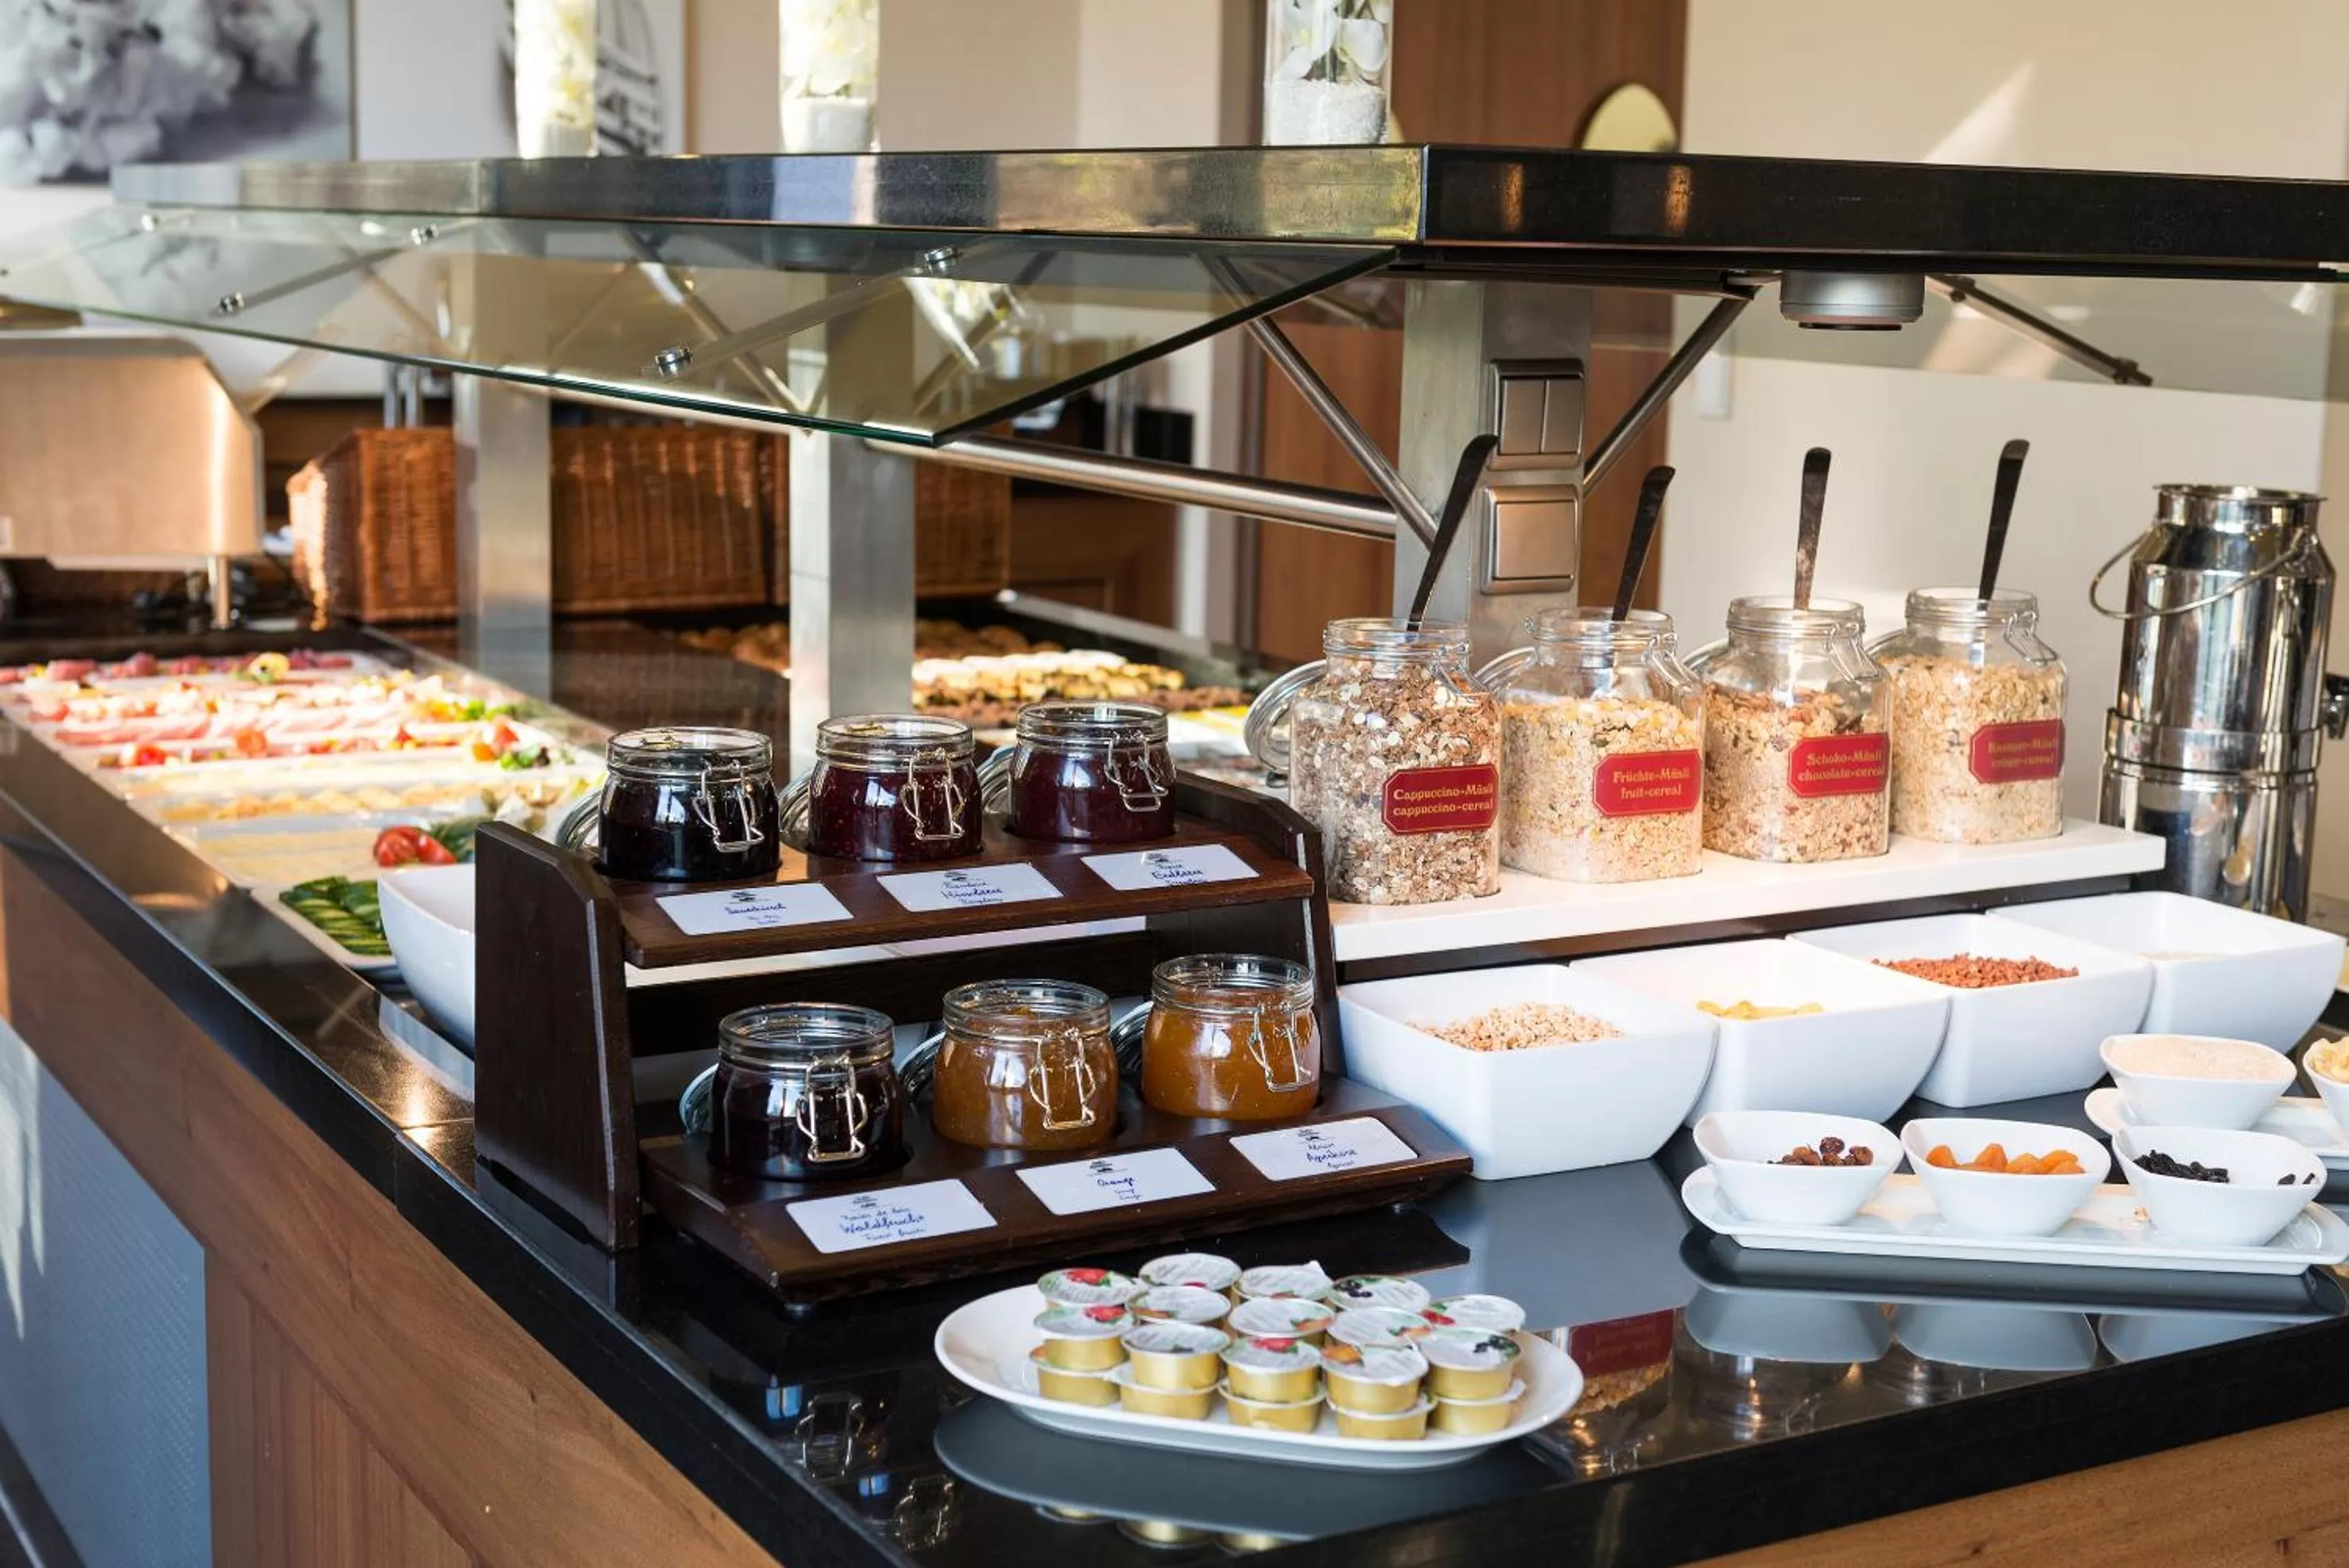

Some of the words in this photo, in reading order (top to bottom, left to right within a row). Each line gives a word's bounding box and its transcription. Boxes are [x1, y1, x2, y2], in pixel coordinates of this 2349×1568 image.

[1806, 750, 1882, 765] Schoko-Müsli
[1612, 767, 1690, 784] Früchte-Müsli
[1393, 784, 1494, 801] Cappuccino-Müsli
[1620, 784, 1682, 800] fruit-cereal
[1393, 799, 1494, 817] cappuccino-cereal
